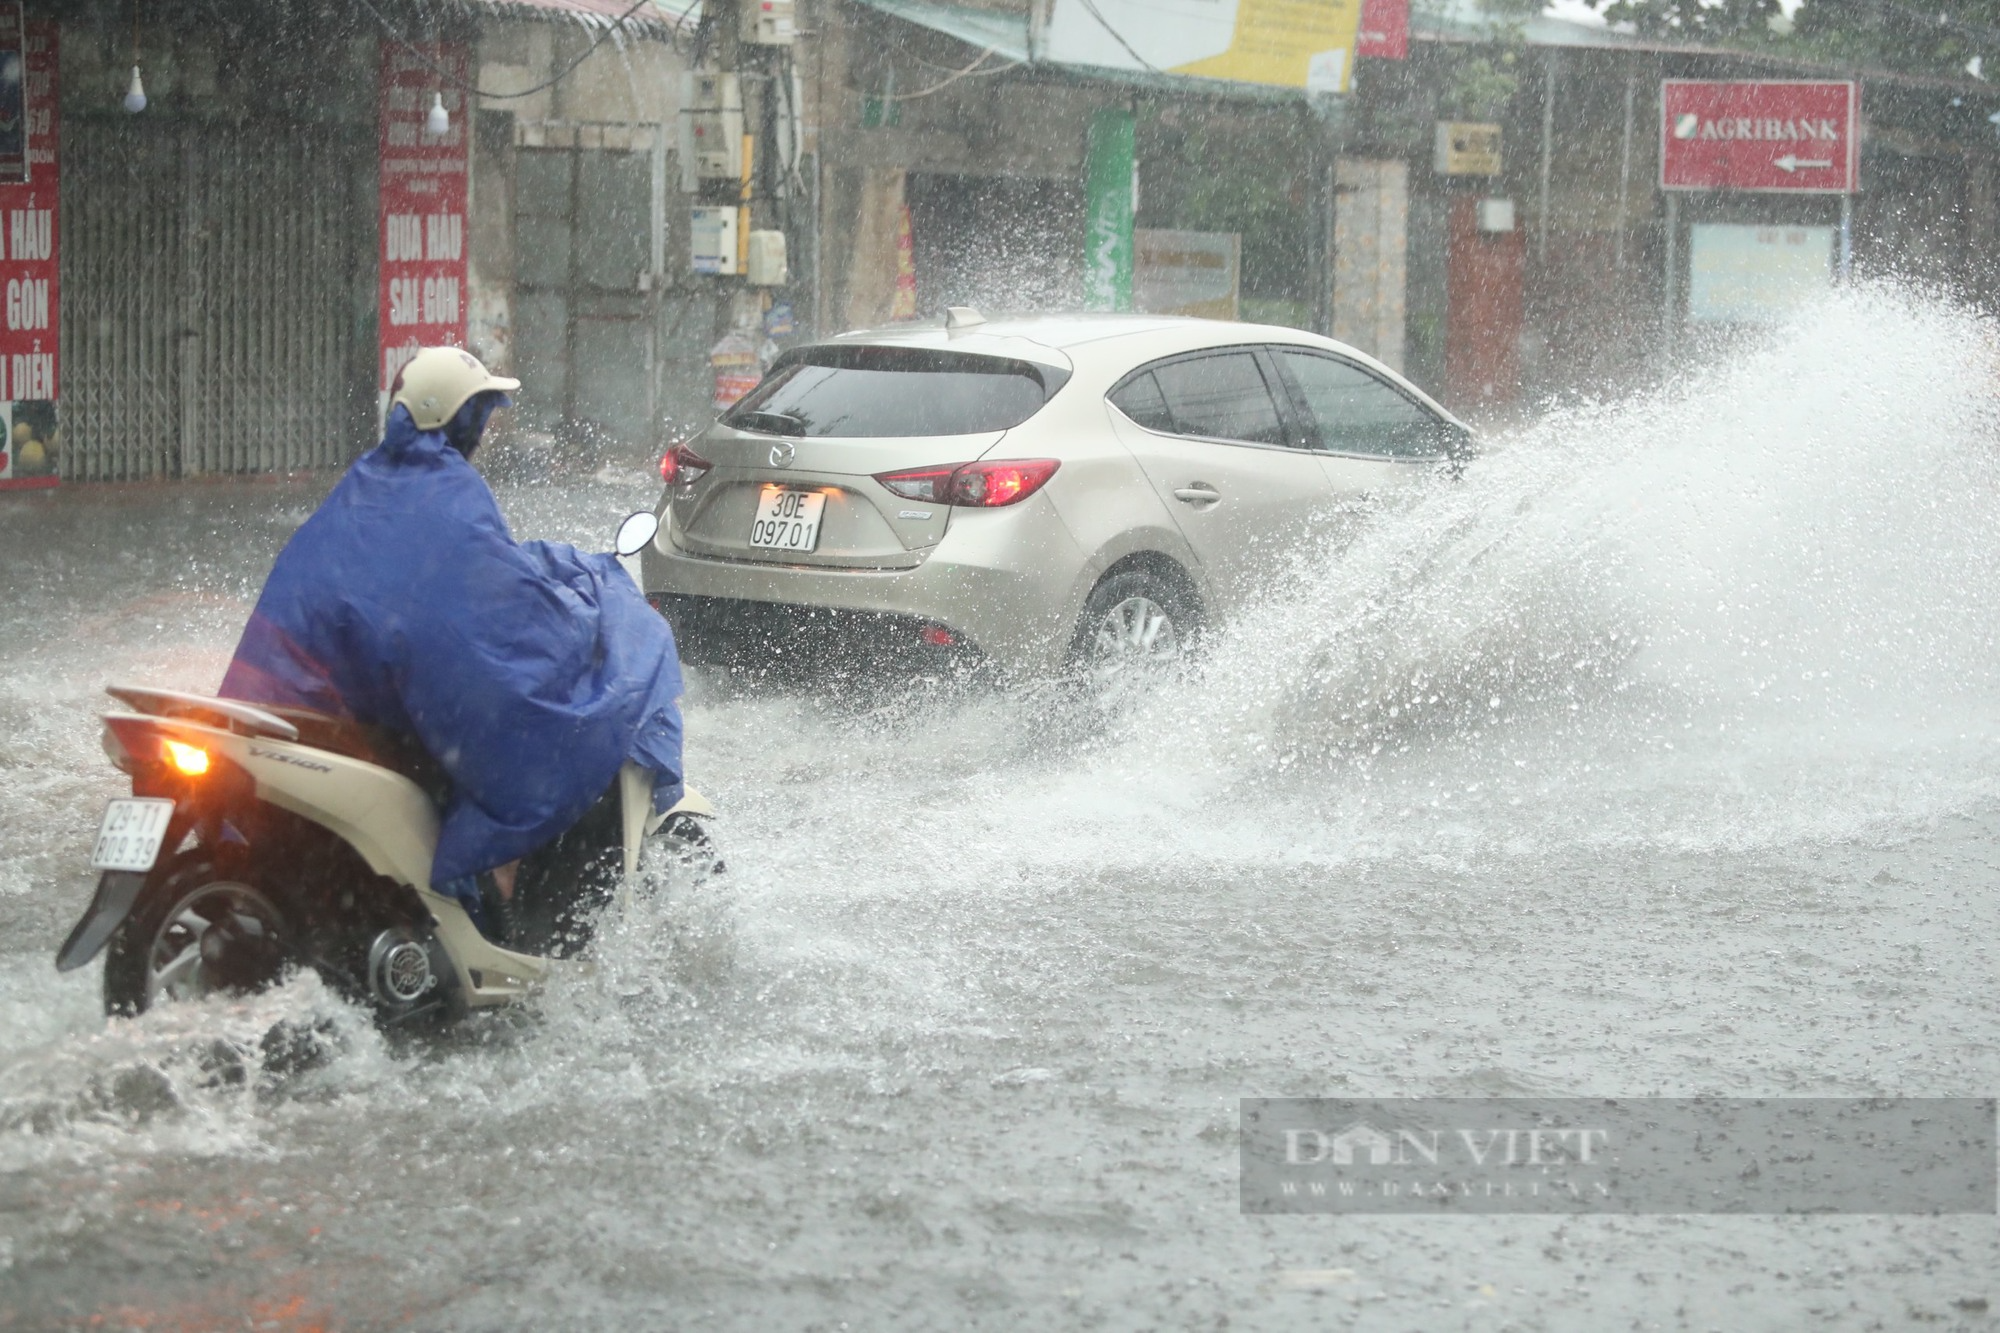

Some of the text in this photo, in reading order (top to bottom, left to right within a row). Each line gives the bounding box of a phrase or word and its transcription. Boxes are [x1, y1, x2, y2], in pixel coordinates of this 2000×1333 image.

[1702, 117, 1838, 142] AGRIBANK
[11, 192, 52, 260] HẤU
[7, 270, 49, 330] GÒN
[13, 339, 53, 400] DIỄN
[771, 493, 809, 519] 30E
[753, 520, 813, 549] 097.01
